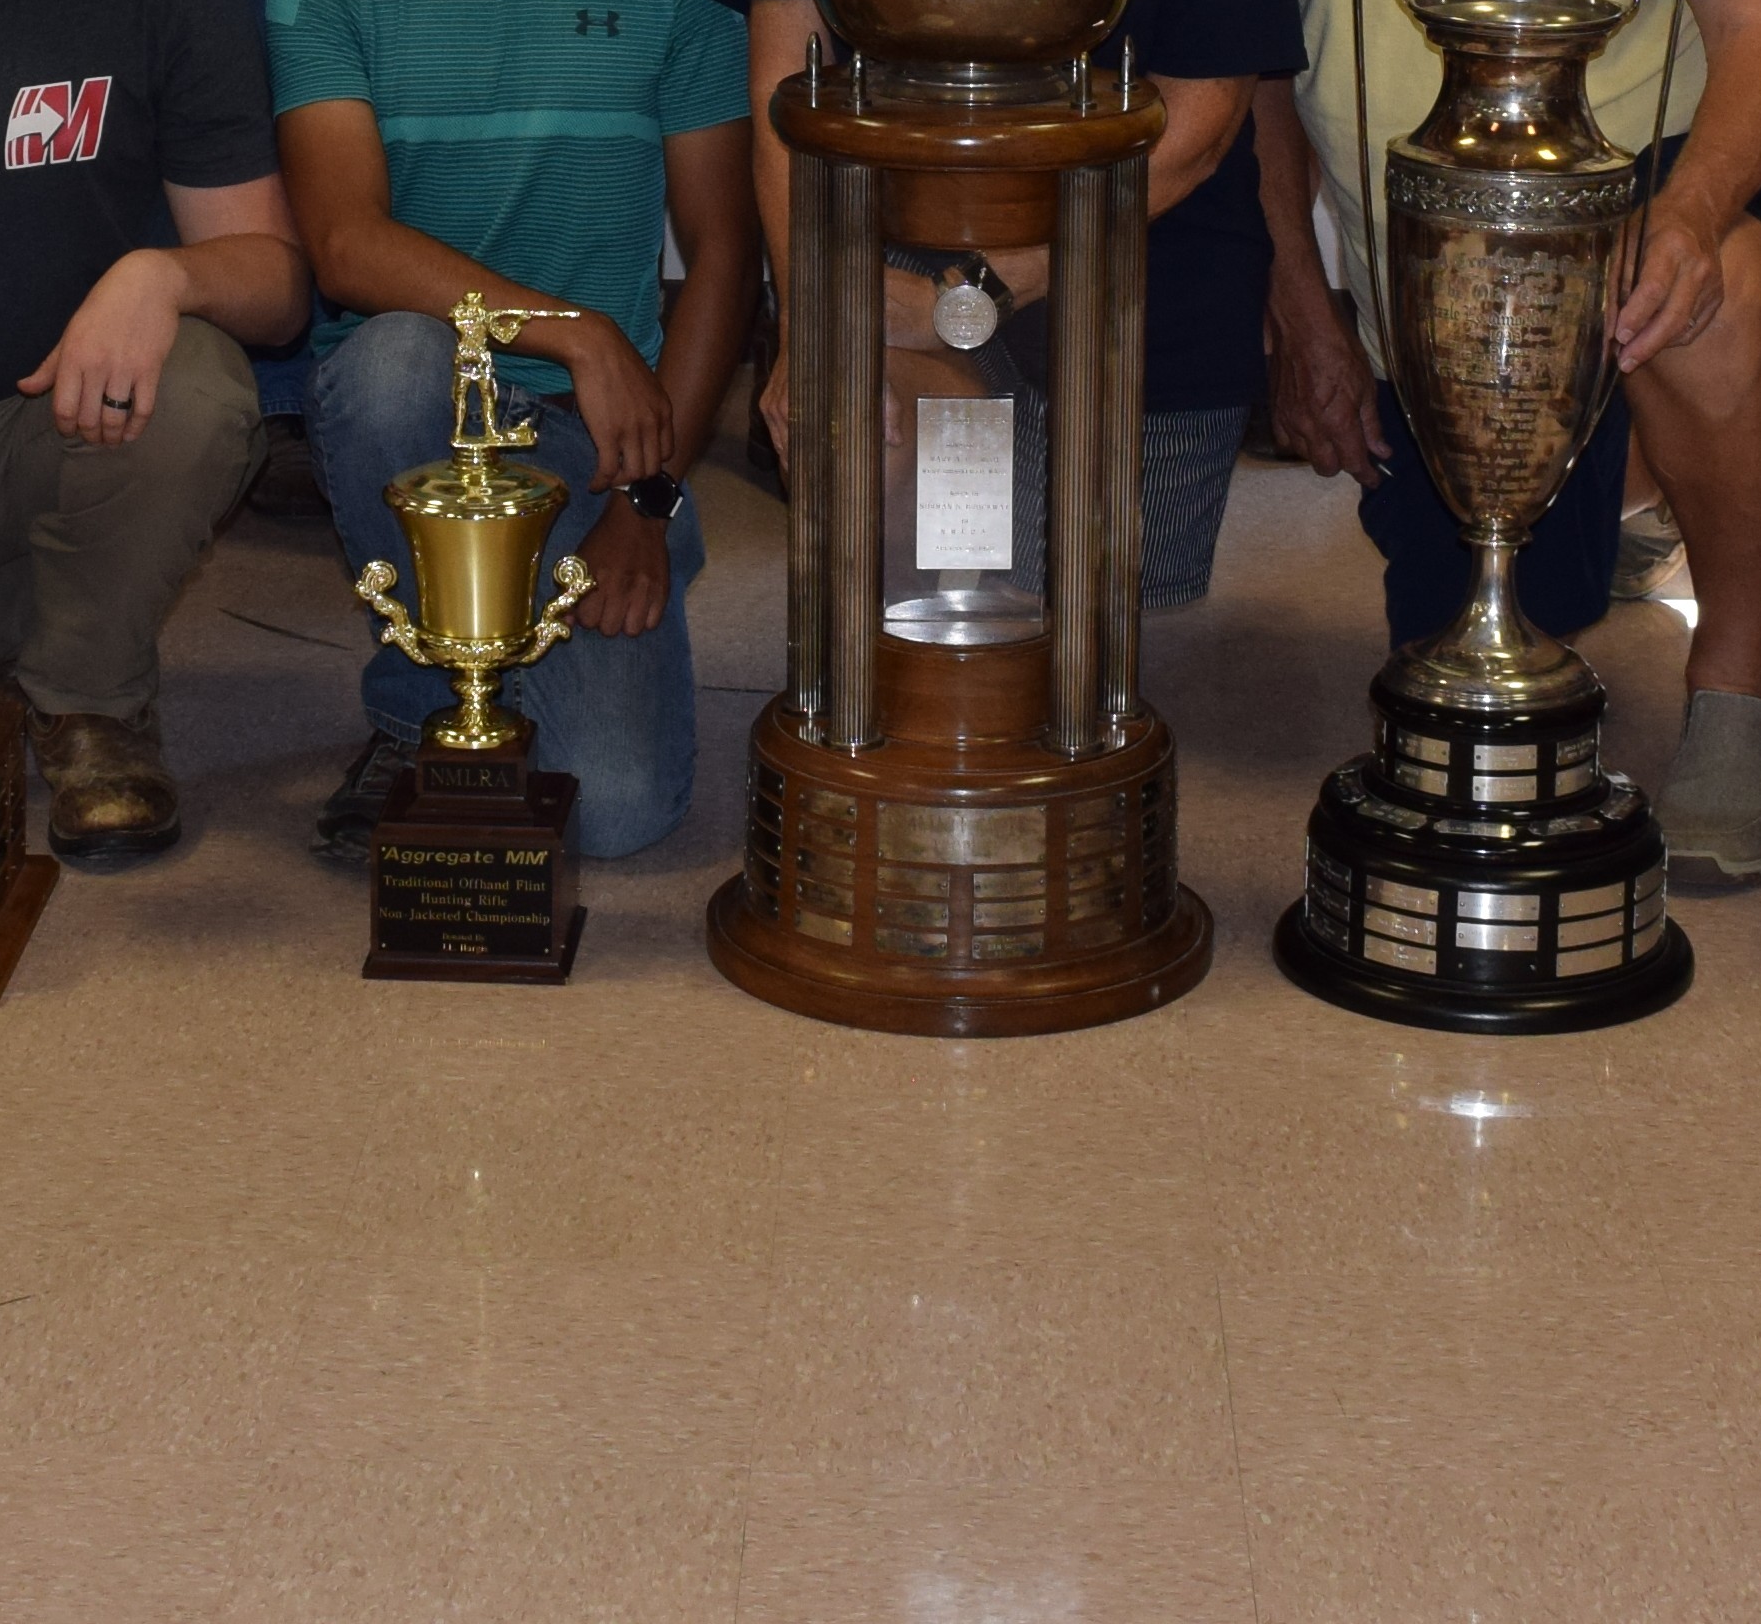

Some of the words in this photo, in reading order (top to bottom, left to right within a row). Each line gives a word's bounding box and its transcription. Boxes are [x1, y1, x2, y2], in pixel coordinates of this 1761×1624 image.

[430, 767, 510, 788] NMLRA
[384, 845, 495, 866] Aggregate
[505, 850, 548, 866] MM
[382, 875, 454, 889] Traditional
[458, 878, 509, 891] Offhand
[515, 879, 547, 892] Flint
[420, 892, 472, 907] Hunting
[478, 895, 509, 907] Rifle
[377, 906, 461, 922] Non-Jacketed
[465, 909, 551, 926] Championship
[442, 932, 473, 942] Donated
